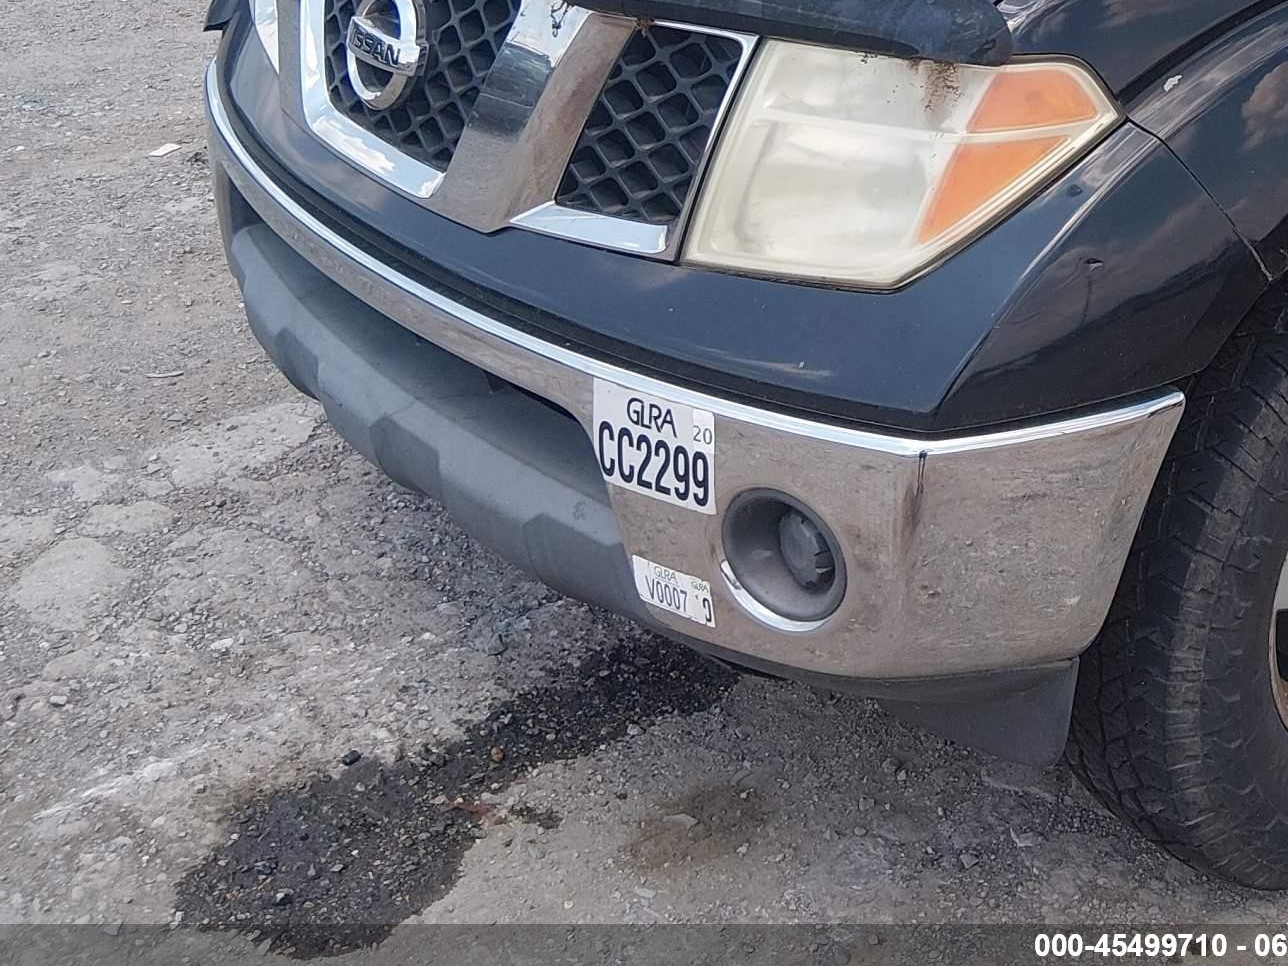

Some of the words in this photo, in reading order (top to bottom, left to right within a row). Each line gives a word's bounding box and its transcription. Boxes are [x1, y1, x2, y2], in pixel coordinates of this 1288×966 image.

[626, 397, 678, 439] GLRA
[693, 425, 713, 445] 20
[598, 420, 709, 507] CC2299
[645, 575, 688, 613] V0007
